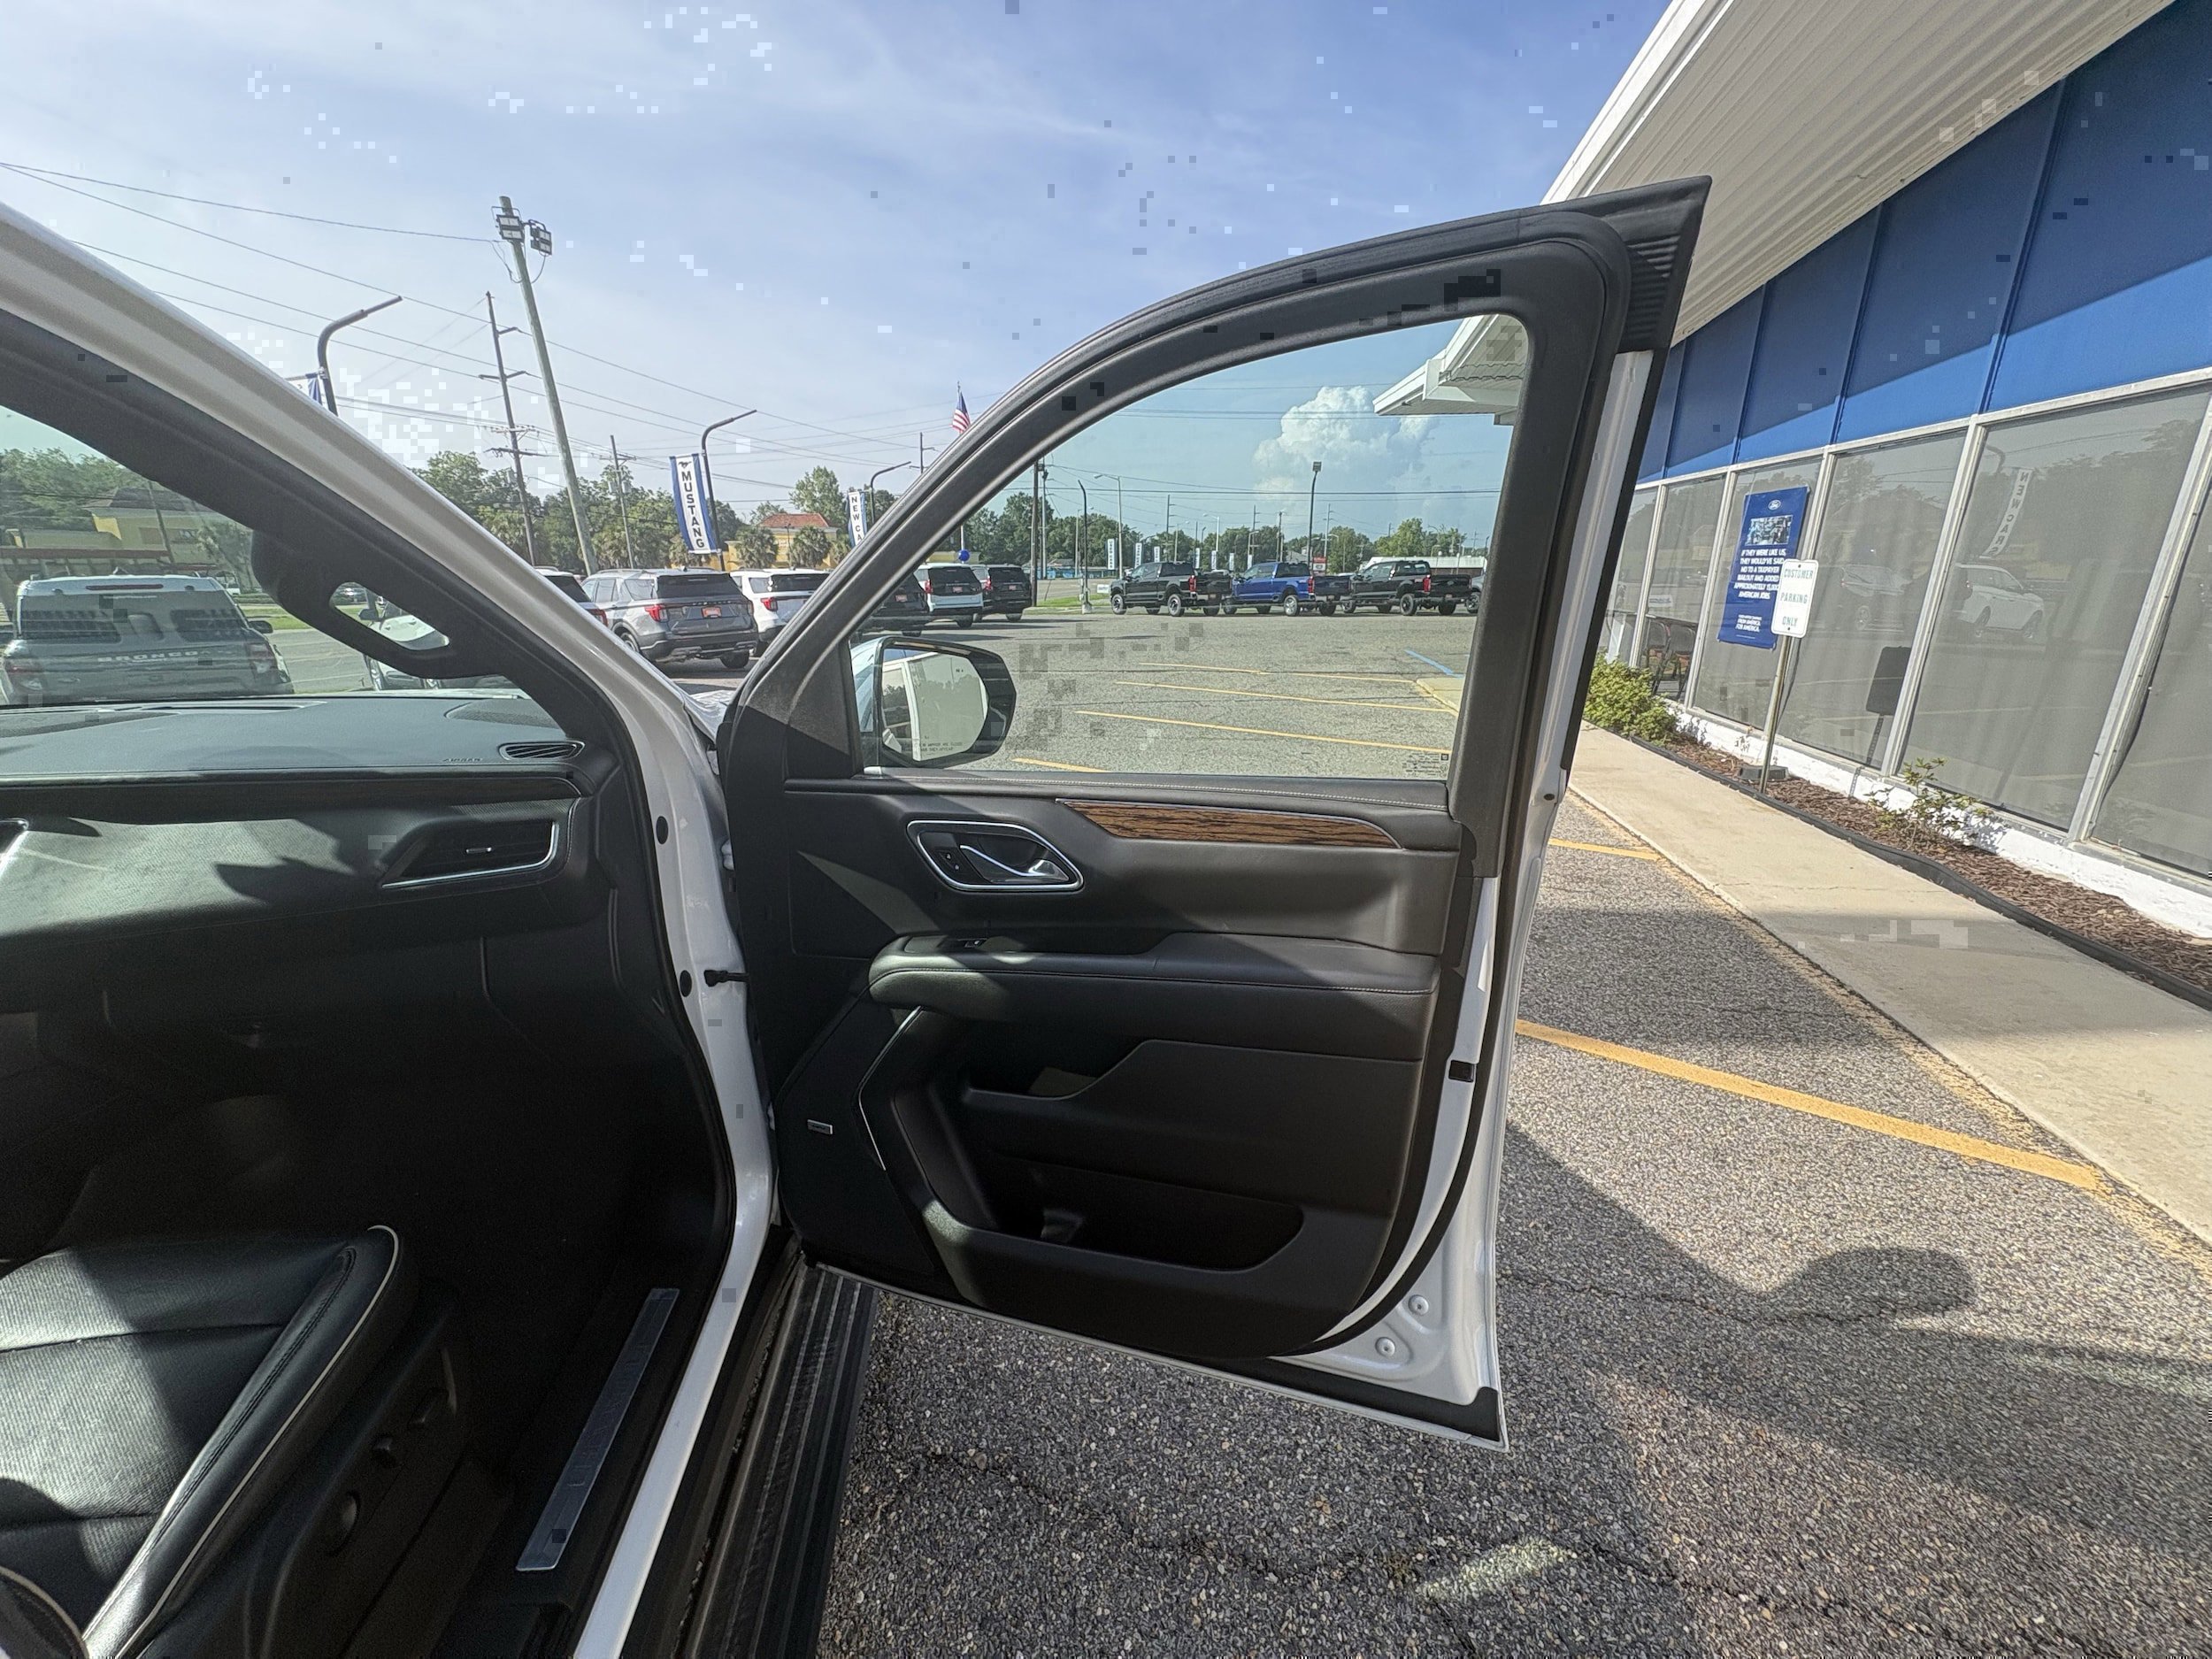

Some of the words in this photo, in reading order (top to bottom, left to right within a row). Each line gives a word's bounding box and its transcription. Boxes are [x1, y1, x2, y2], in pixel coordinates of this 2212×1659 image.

[681, 471, 705, 549] MUSTANG
[1784, 569, 1813, 580] CUSTOMER
[1780, 592, 1808, 604] PARKING
[1782, 616, 1798, 626] ONLY
[97, 651, 198, 663] BRONCO
